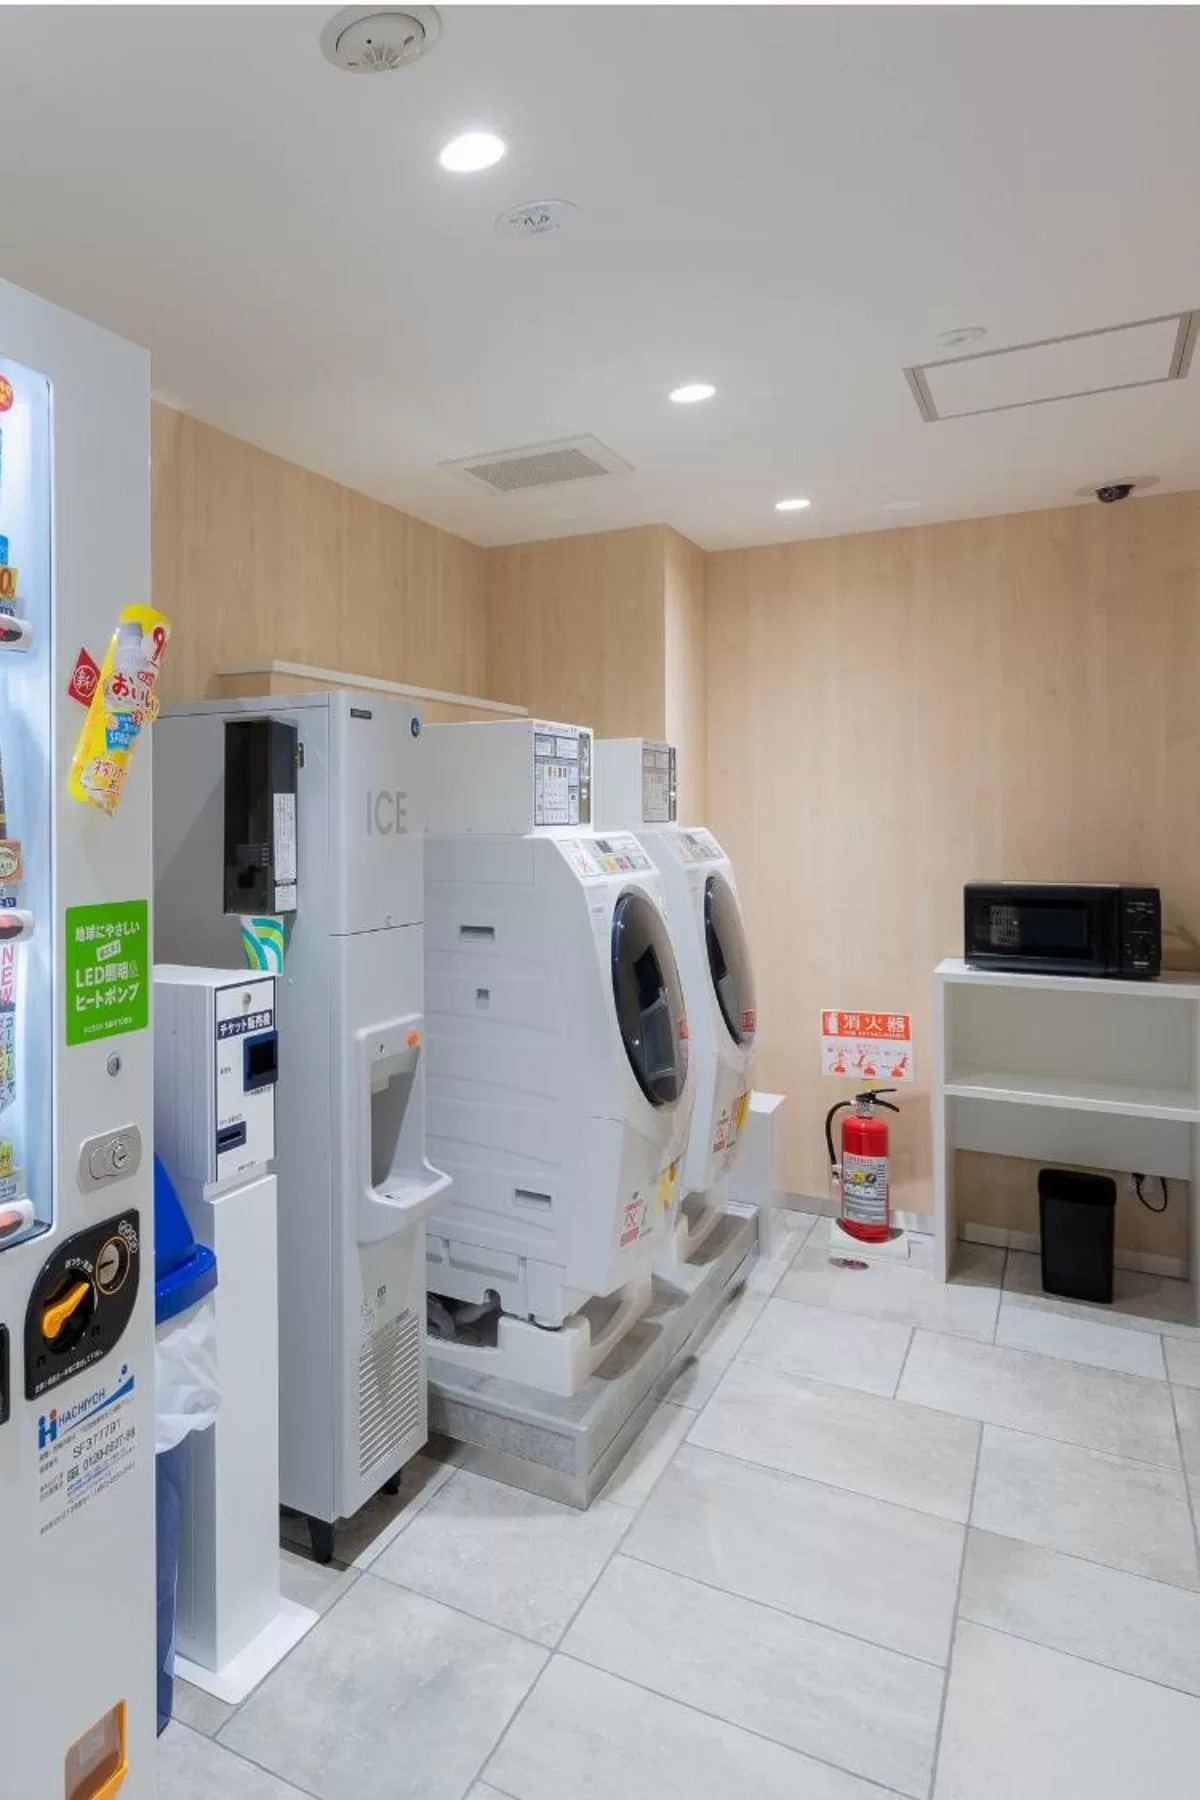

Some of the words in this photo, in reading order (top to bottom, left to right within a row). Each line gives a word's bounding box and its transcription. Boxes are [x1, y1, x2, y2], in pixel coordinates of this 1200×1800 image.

[366, 789, 408, 835] ICE
[0, 945, 16, 1006] NEW
[843, 1013, 905, 1033] 消火器
